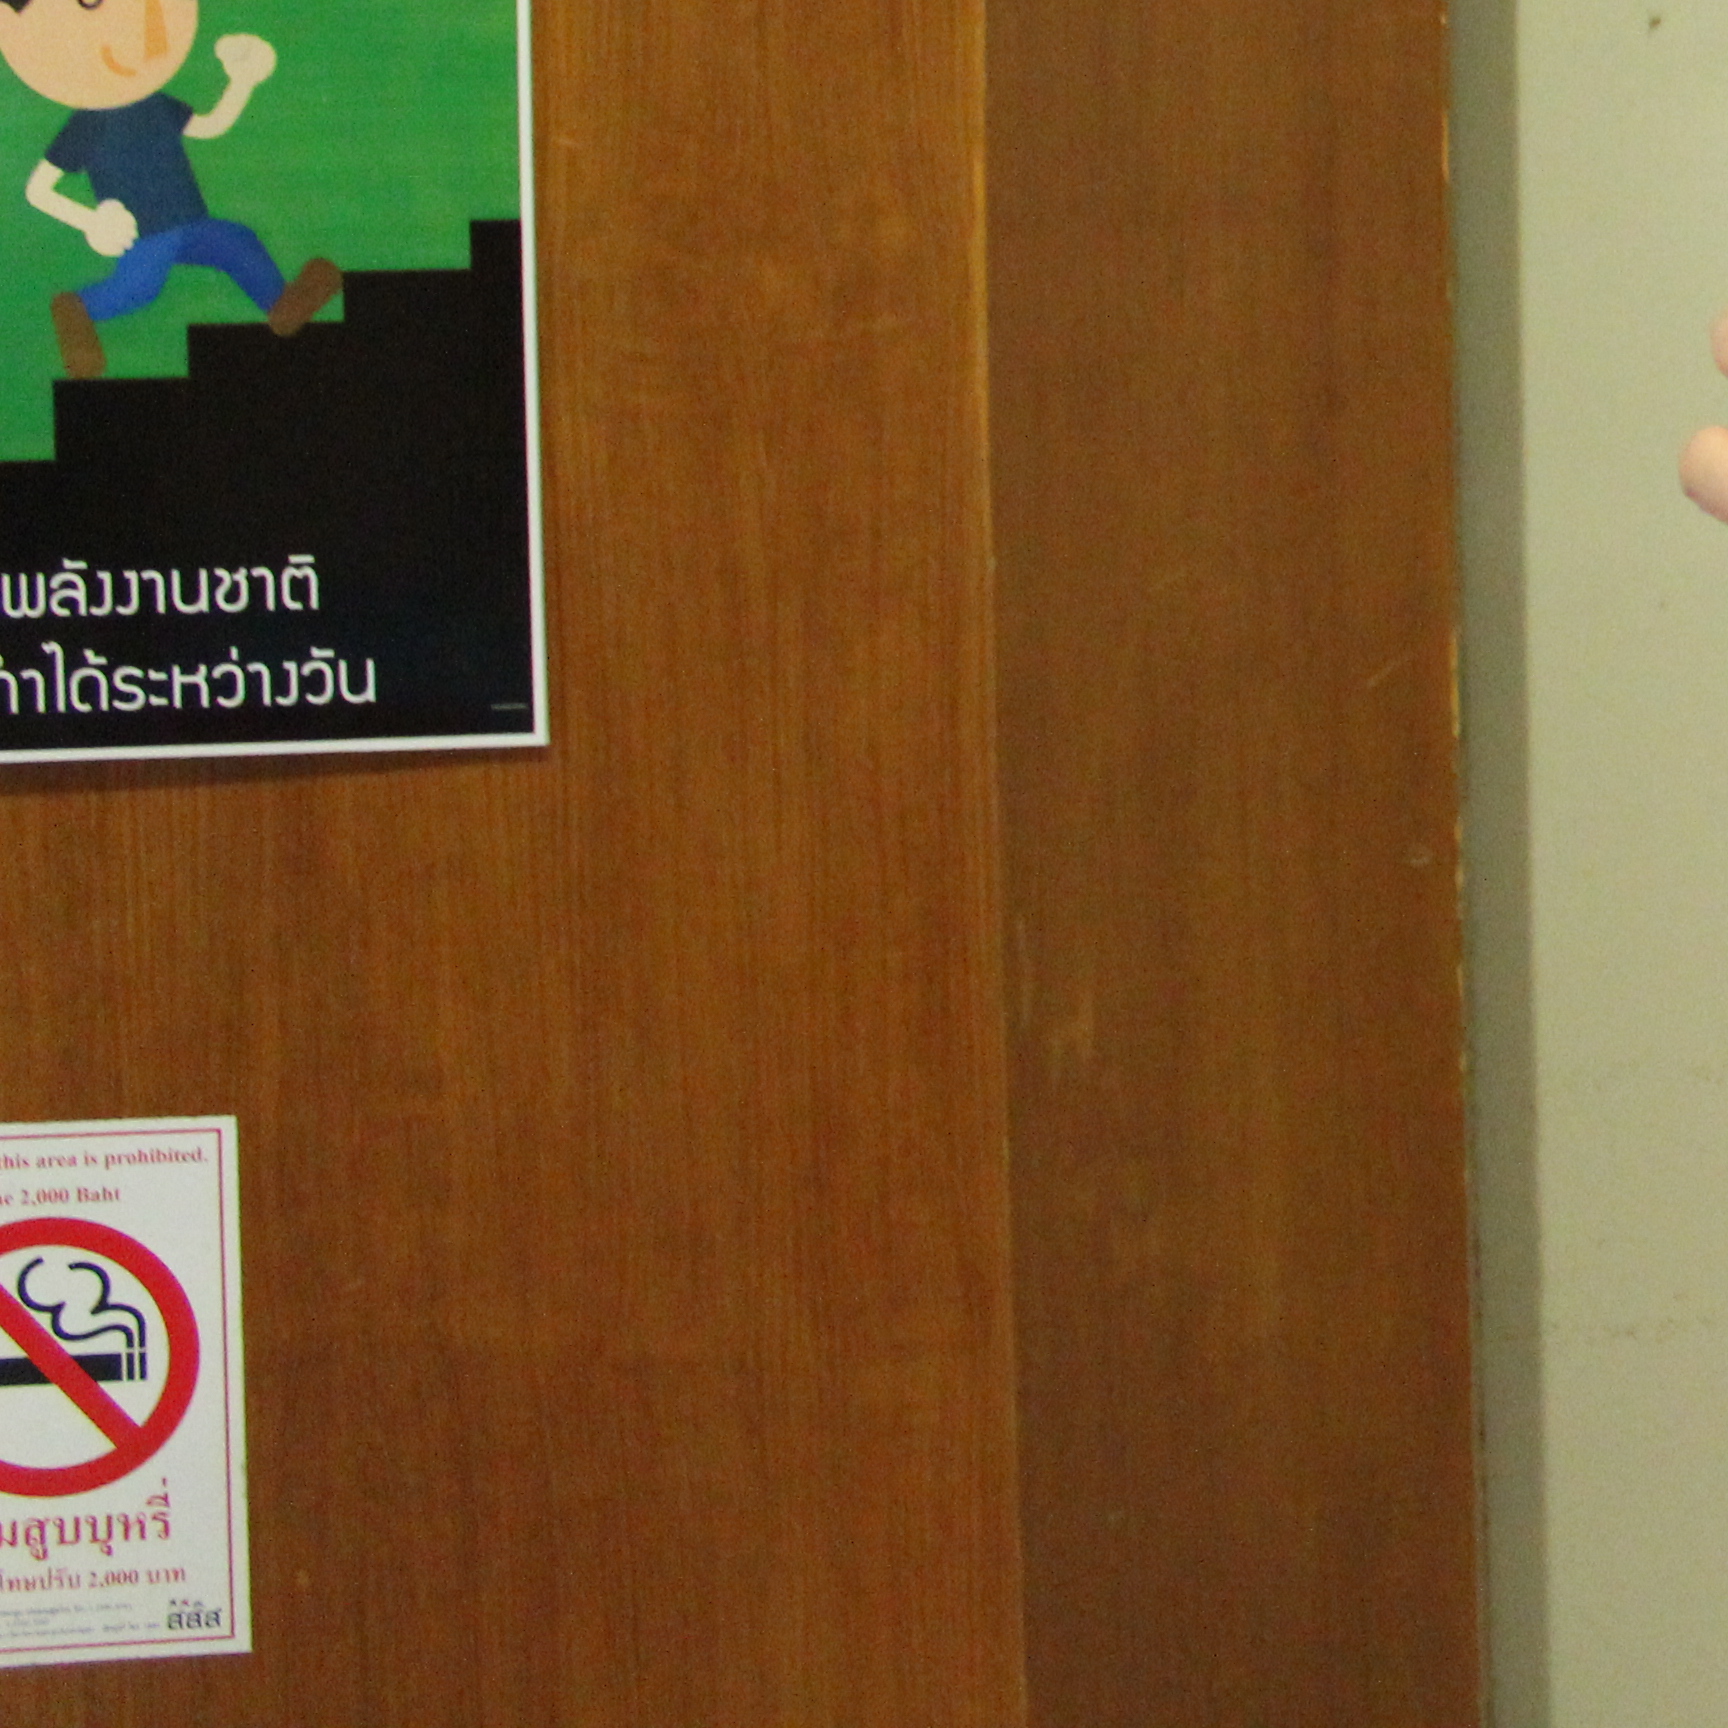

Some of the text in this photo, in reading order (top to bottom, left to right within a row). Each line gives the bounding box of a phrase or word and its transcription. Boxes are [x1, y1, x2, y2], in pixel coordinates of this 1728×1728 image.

[0, 1147, 208, 1170] his area is prohibited.
[77, 1186, 122, 1204] Baht
